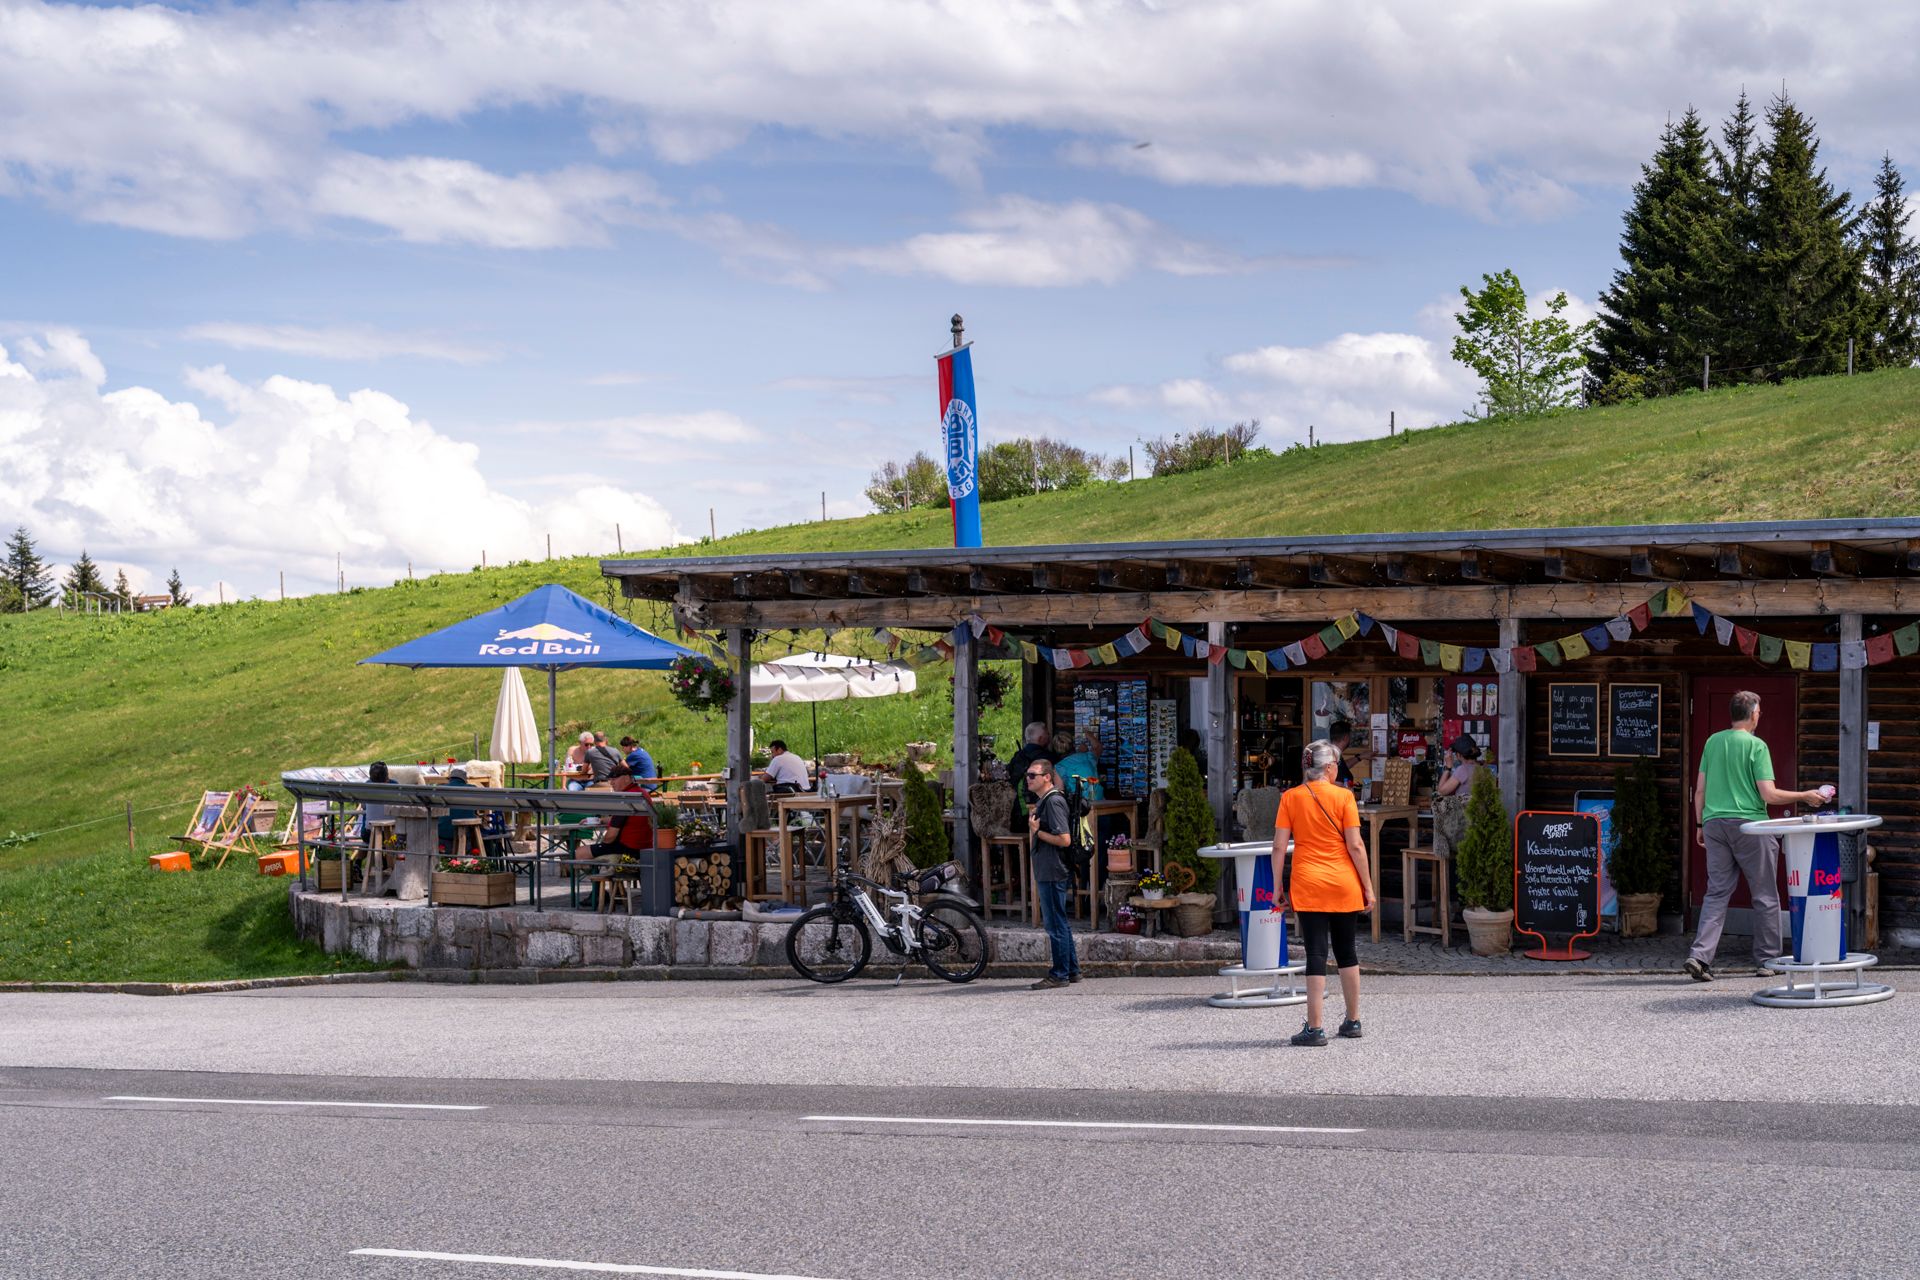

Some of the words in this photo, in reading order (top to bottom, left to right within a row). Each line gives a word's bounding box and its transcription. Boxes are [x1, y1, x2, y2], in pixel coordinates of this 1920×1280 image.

[479, 642, 539, 655] Red
[542, 642, 600, 655] Bull
[1542, 822, 1573, 836] APEROL
[1547, 830, 1568, 839] SPRITZ
[1789, 870, 1799, 886] ull
[1255, 888, 1274, 902] Re
